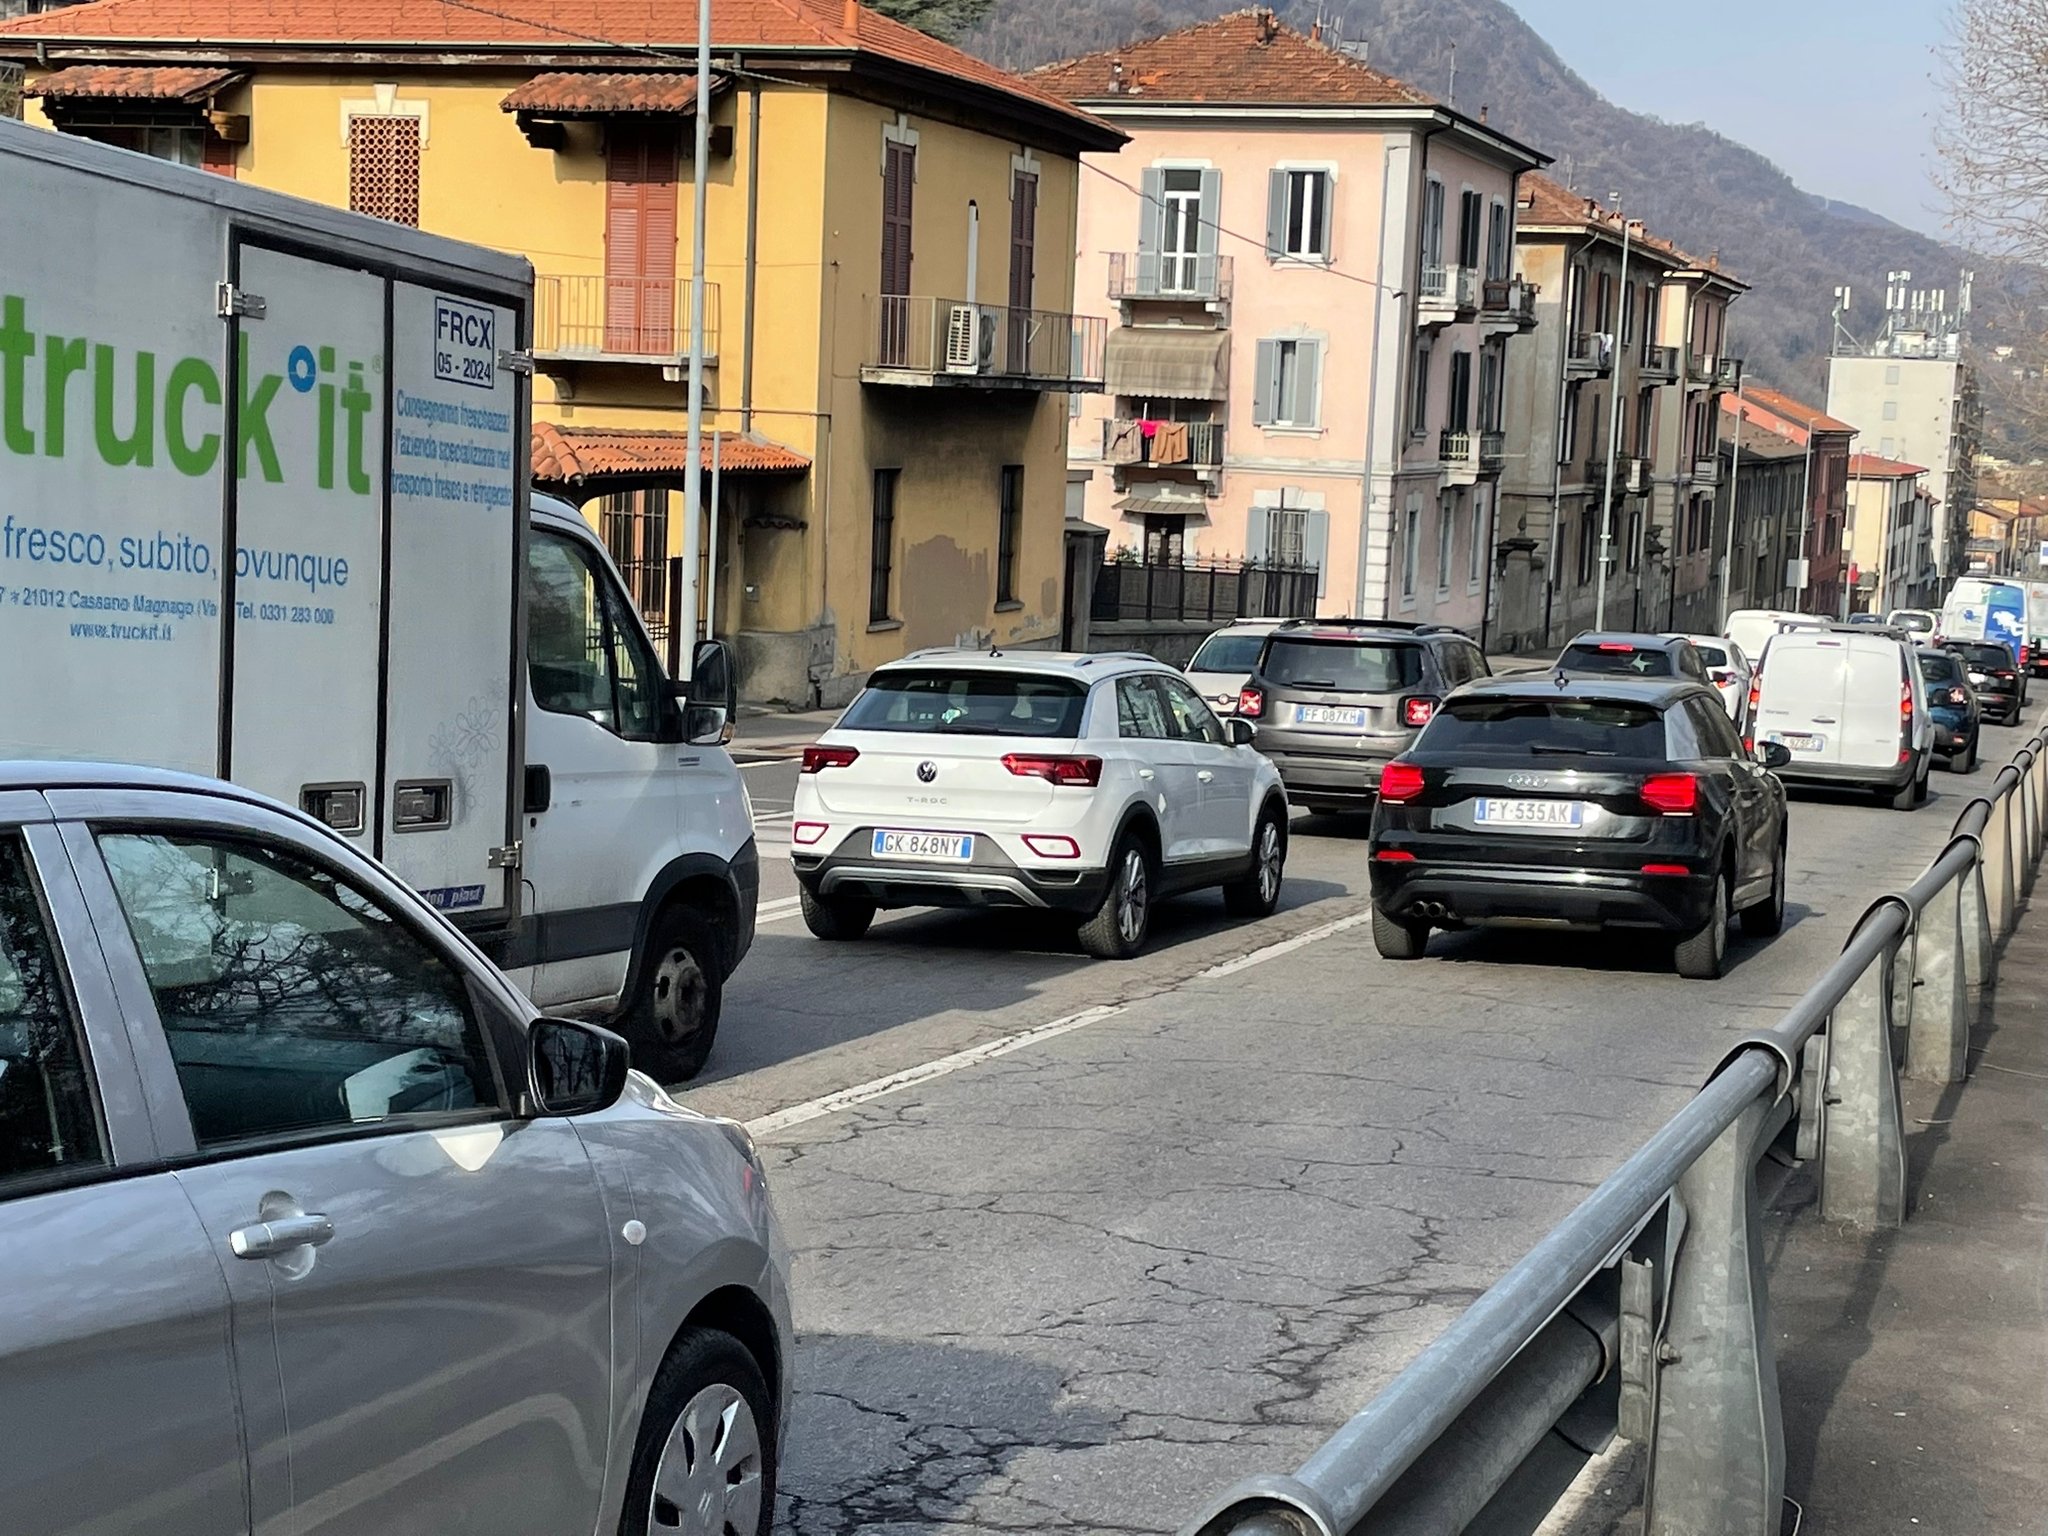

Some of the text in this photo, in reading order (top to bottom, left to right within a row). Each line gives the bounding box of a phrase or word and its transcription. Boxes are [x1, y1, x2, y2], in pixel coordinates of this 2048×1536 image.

[438, 307, 491, 350] FRCX
[437, 352, 452, 374] 05
[463, 357, 491, 382] 2024
[235, 547, 349, 593] ovunque
[23, 587, 65, 608] 21012
[69, 590, 130, 612] Cassano
[133, 594, 194, 619] Magnago
[236, 601, 256, 619] Tel.
[259, 603, 287, 623] 0331
[70, 622, 172, 641] www.truckit.it
[1303, 708, 1358, 725] FF 087KH
[907, 796, 947, 805] T-ROC
[1487, 801, 1569, 822] FY 535AK
[885, 834, 905, 852] GK
[909, 835, 961, 856] 848NY
